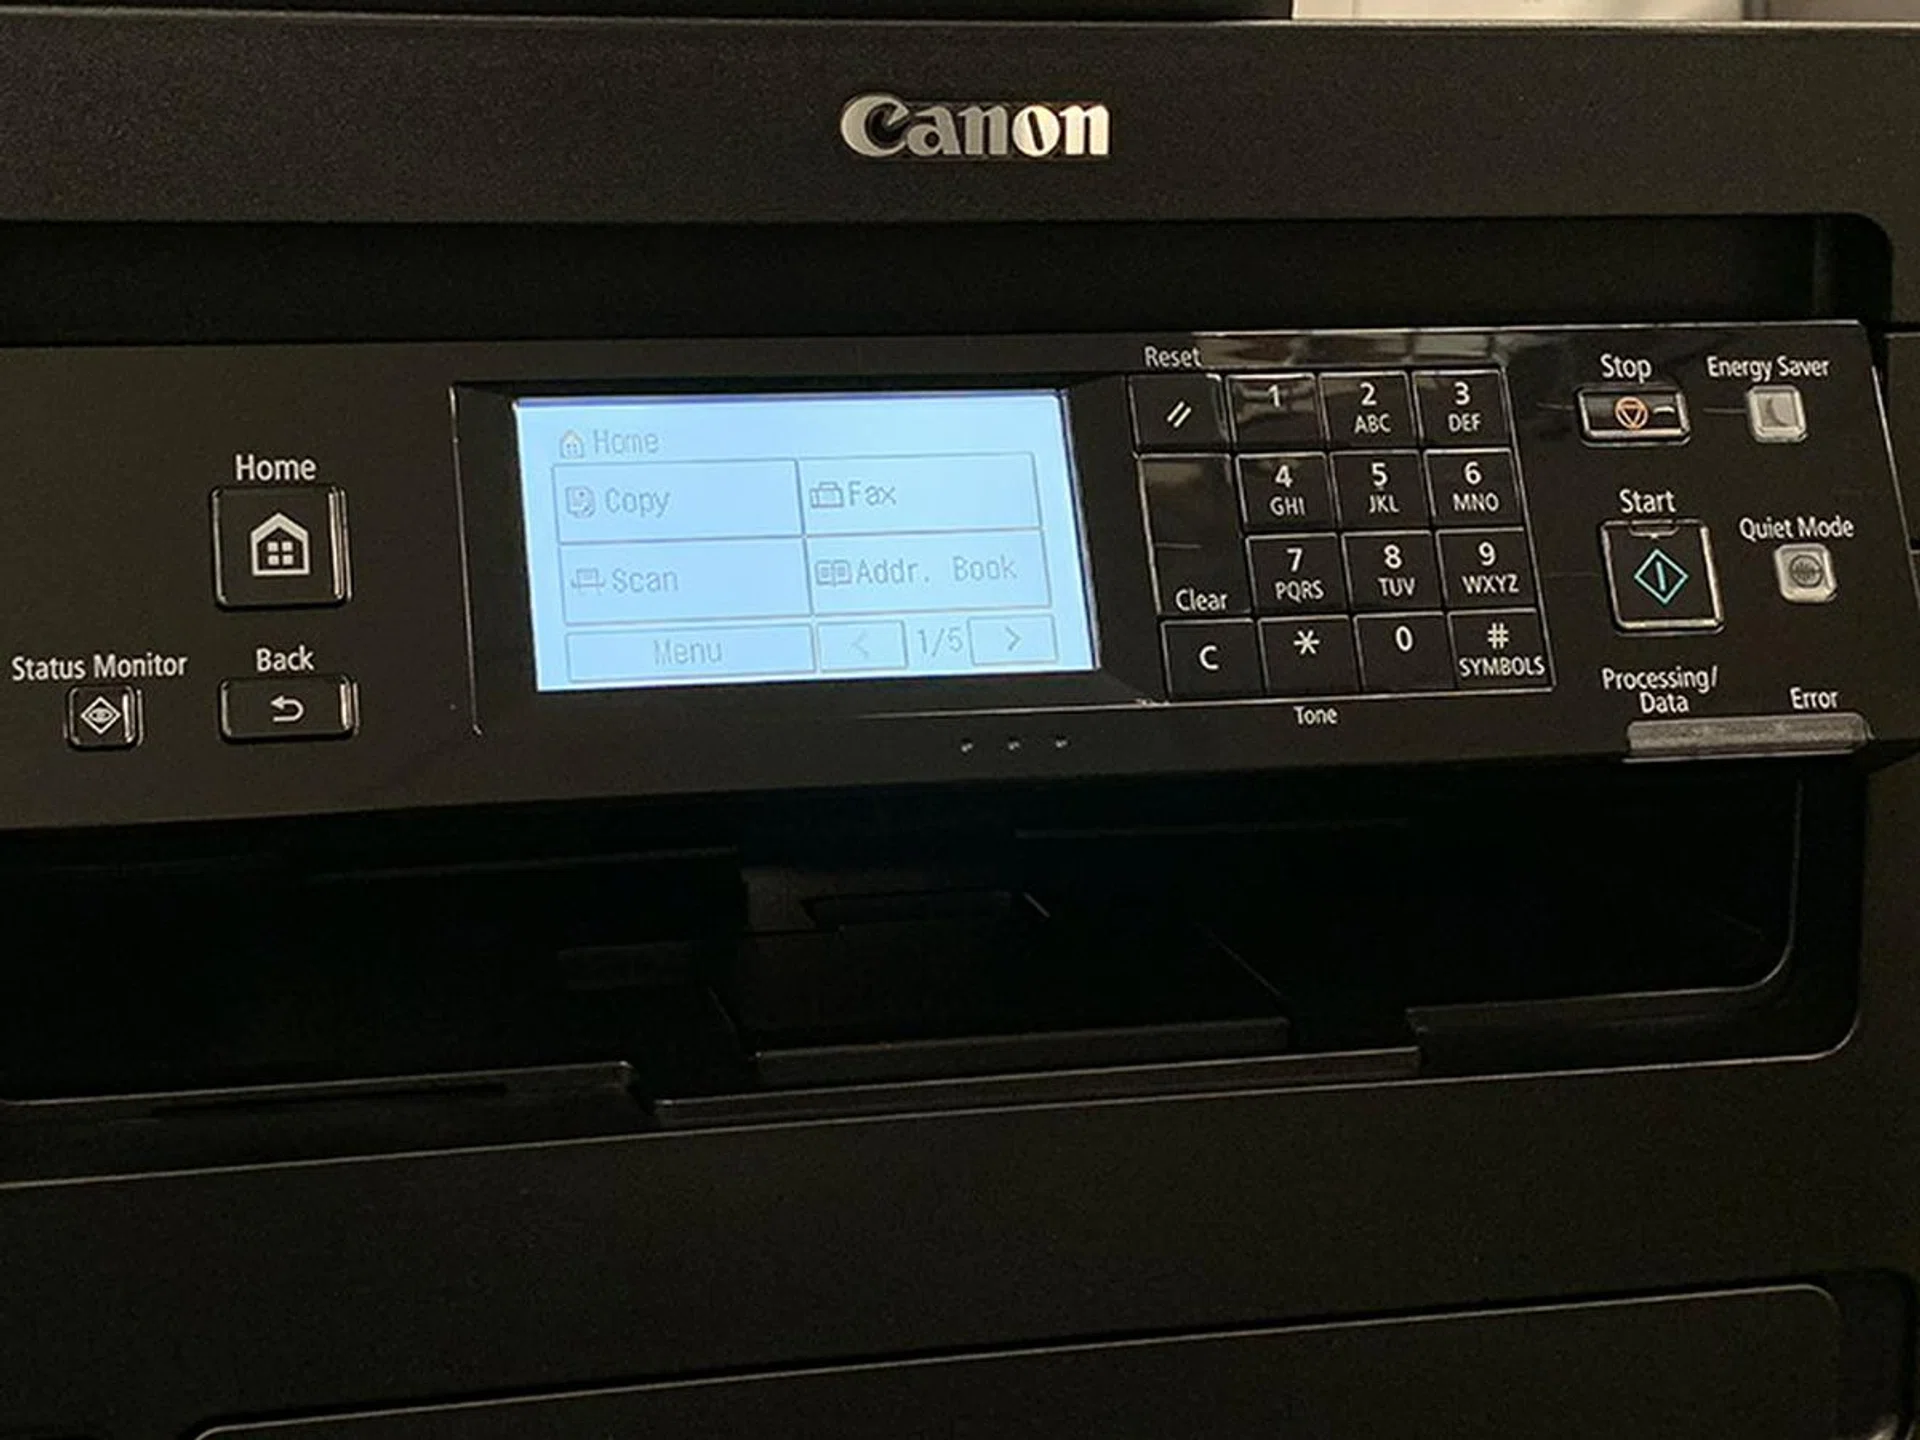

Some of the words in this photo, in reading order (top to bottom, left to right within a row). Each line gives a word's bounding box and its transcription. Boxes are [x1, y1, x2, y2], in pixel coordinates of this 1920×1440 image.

[840, 94, 1109, 157] Canon
[1144, 346, 1201, 368] Reset
[1600, 353, 1653, 384] Stop
[1707, 356, 1773, 382] Energy
[1778, 355, 1831, 377] Saver
[1267, 384, 1281, 408] 1
[1360, 381, 1378, 406] 2
[1454, 381, 1470, 405] 3
[1354, 413, 1391, 434] ABC
[1448, 413, 1482, 432] DEF
[593, 429, 659, 456] Home
[235, 453, 317, 482] Home
[1274, 464, 1293, 488] 4
[1372, 462, 1388, 487] 5
[1465, 460, 1482, 484] 6
[604, 486, 671, 518] Copy
[848, 481, 897, 507] Fax
[1269, 496, 1305, 517] GHI
[1369, 494, 1400, 514] JKL
[1453, 493, 1499, 512] MNO
[1619, 489, 1677, 514] Start
[1739, 517, 1794, 541] Quiet
[1798, 516, 1855, 538] Mode
[1286, 547, 1302, 572] 7
[1384, 544, 1402, 569] 8
[1478, 541, 1496, 566] 9
[611, 566, 679, 594] Scan
[856, 557, 931, 586] Addr.
[953, 555, 1018, 581] Book
[1275, 580, 1324, 602] PQRS
[1378, 577, 1416, 598] TUV
[1462, 574, 1520, 596] WXYZ
[1176, 588, 1228, 613] Clear
[917, 626, 963, 658] 1/5
[1396, 626, 1413, 652] 0
[1487, 623, 1509, 650] #
[256, 645, 315, 672] Back
[652, 638, 723, 666] Menu
[1200, 645, 1219, 670] C
[12, 655, 85, 681] Status
[94, 652, 188, 678] Monitor
[1459, 655, 1545, 678] SYMBOLS
[1602, 665, 1718, 693] Processing/
[1640, 694, 1689, 715] Data
[1790, 687, 1838, 710] Error
[1293, 705, 1338, 726] Tone
